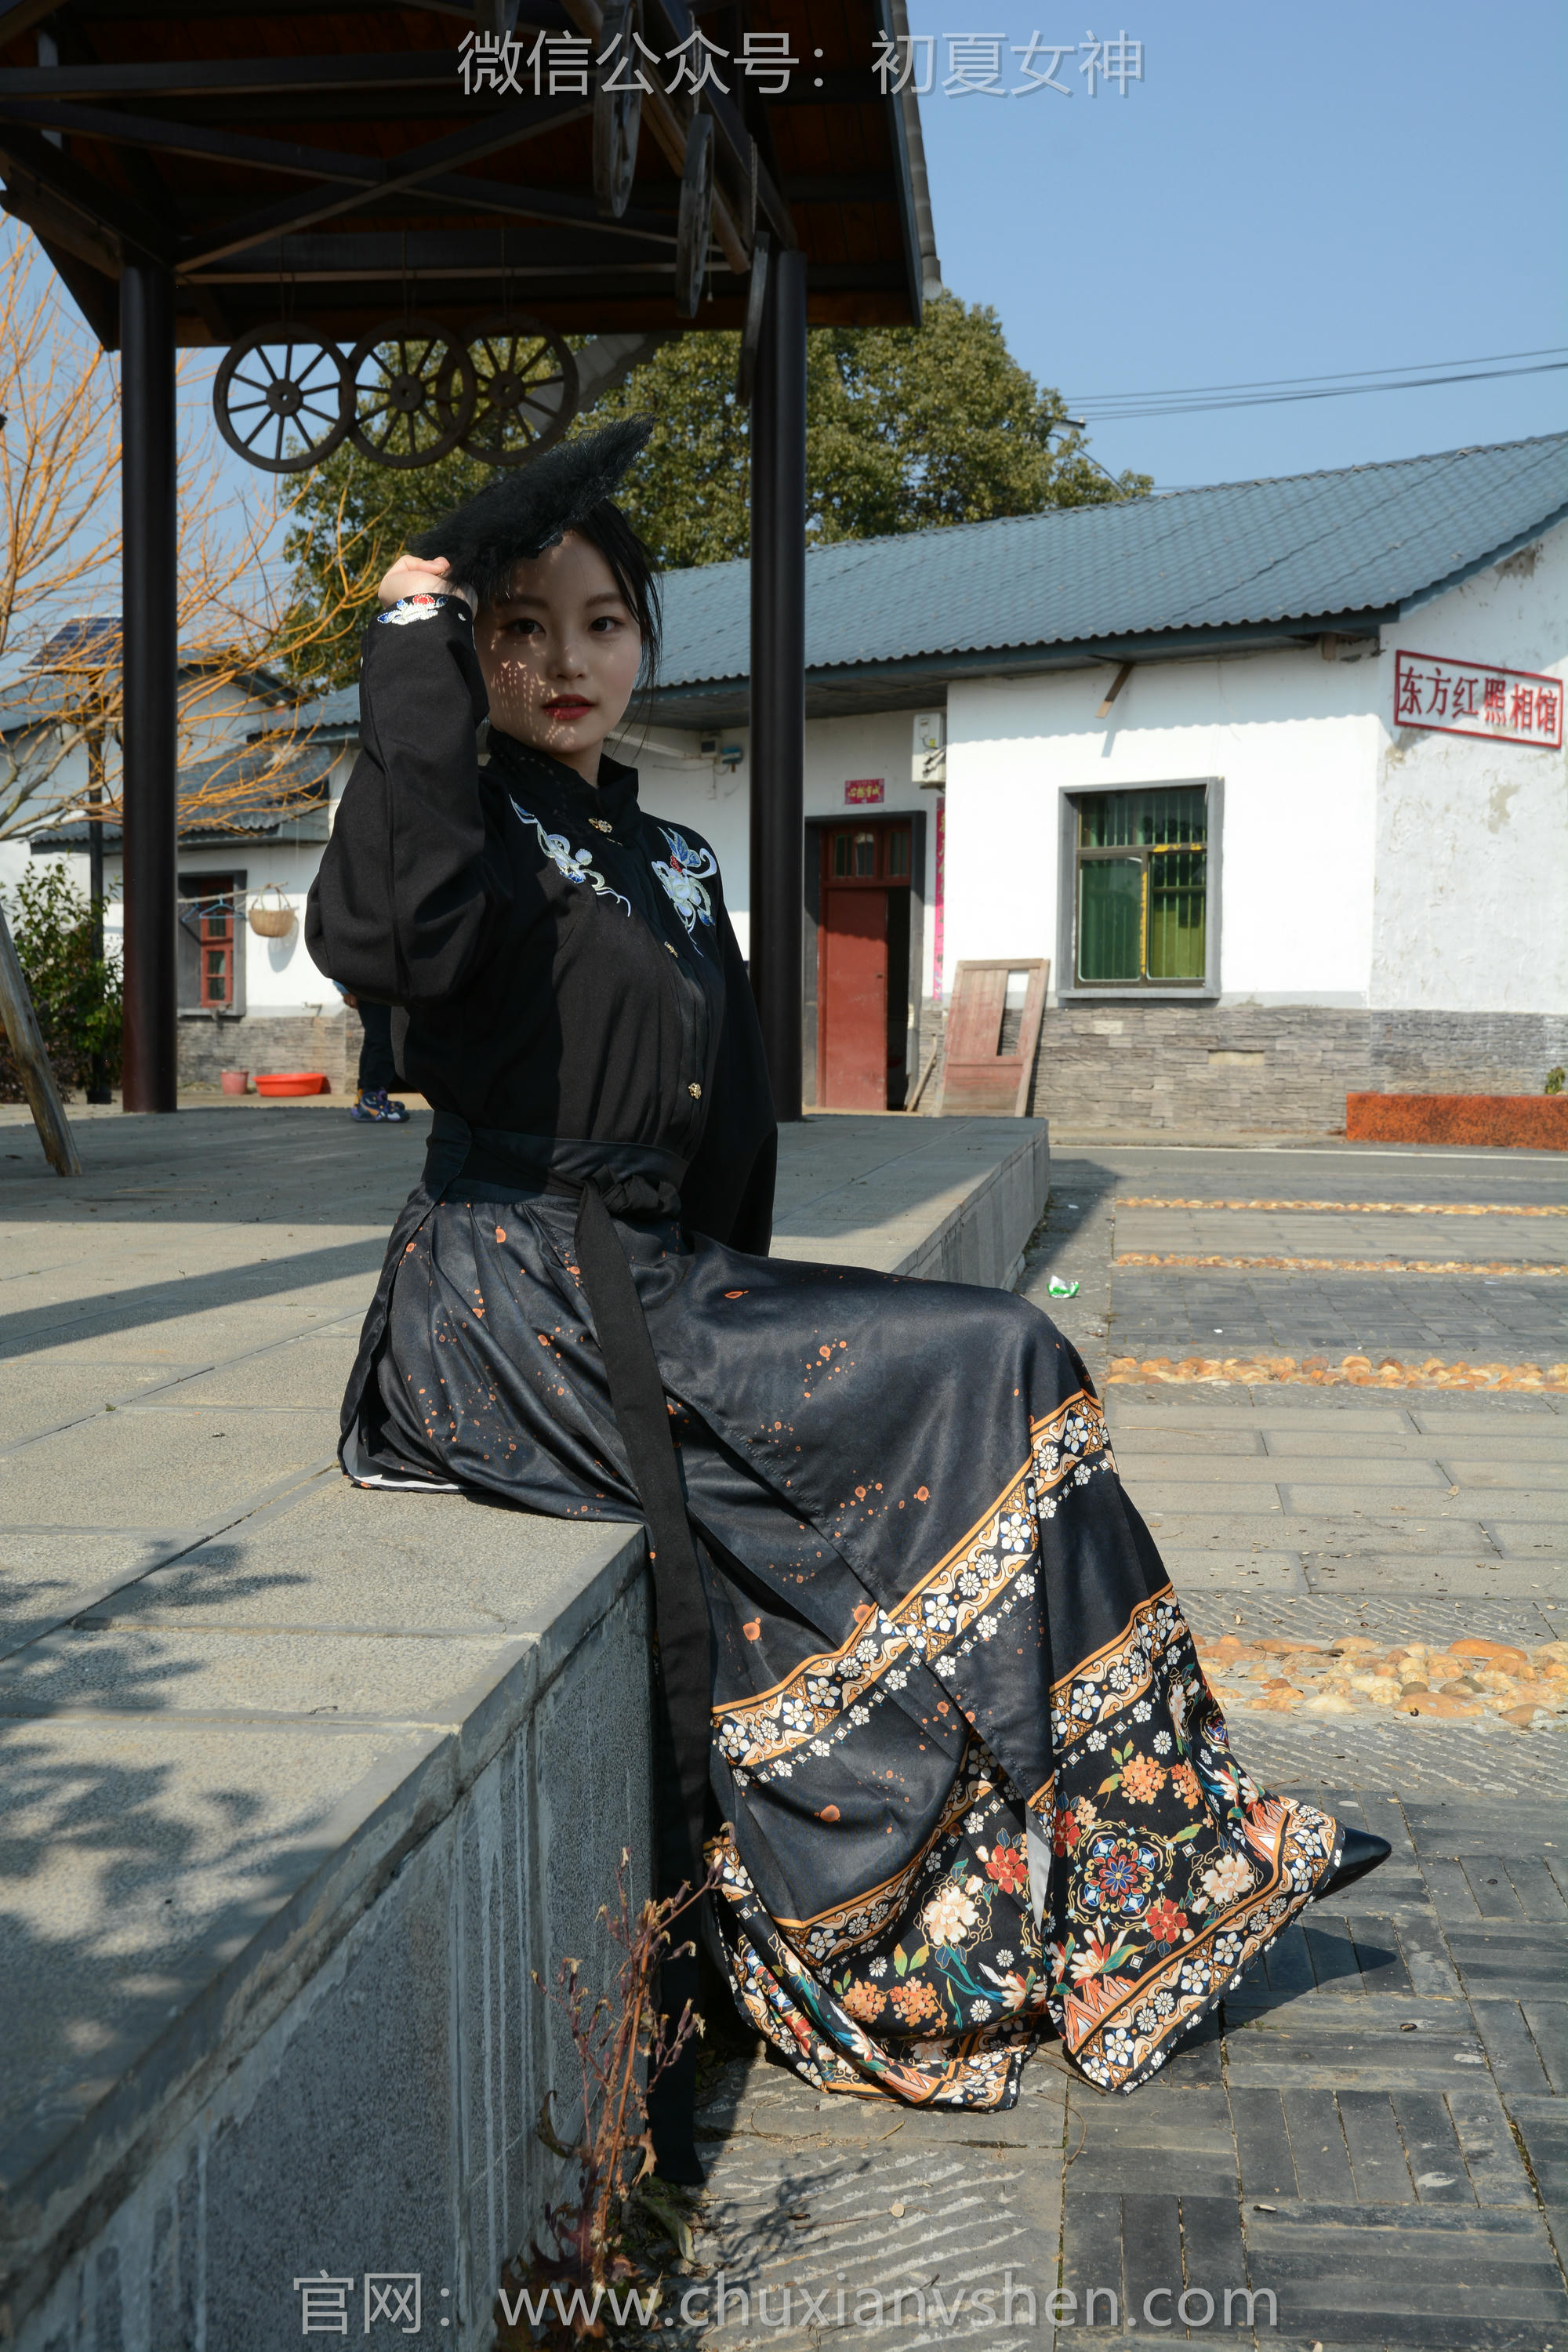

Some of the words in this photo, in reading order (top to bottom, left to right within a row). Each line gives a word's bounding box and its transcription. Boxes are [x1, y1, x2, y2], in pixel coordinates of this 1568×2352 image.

[1399, 666, 1558, 733] 东方红照相馆
